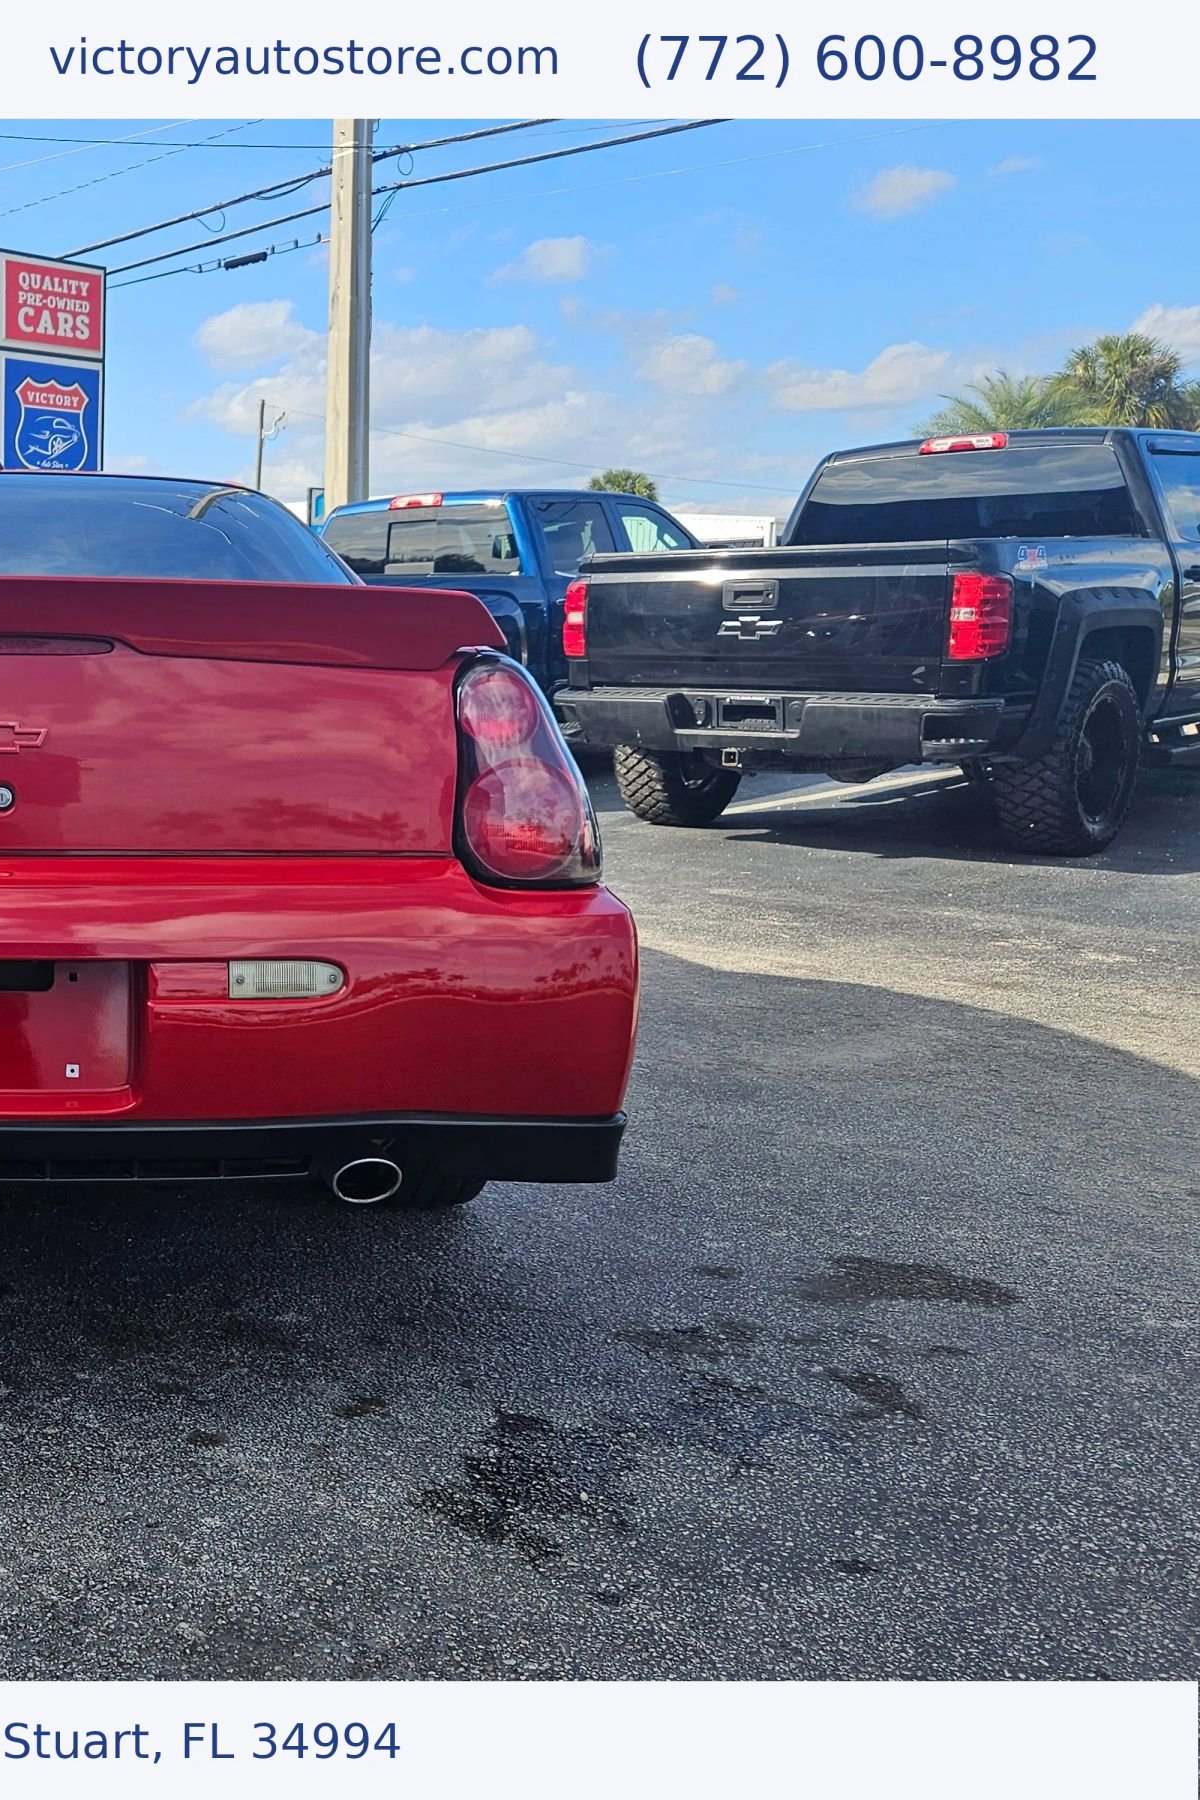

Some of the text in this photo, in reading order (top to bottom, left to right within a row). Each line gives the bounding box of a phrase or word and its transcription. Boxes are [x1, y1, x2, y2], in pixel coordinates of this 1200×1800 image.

[18, 271, 90, 297] QUALITY
[18, 291, 90, 313] PRE-OWNED
[17, 306, 90, 341] CARS
[26, 391, 79, 407] VICTORY
